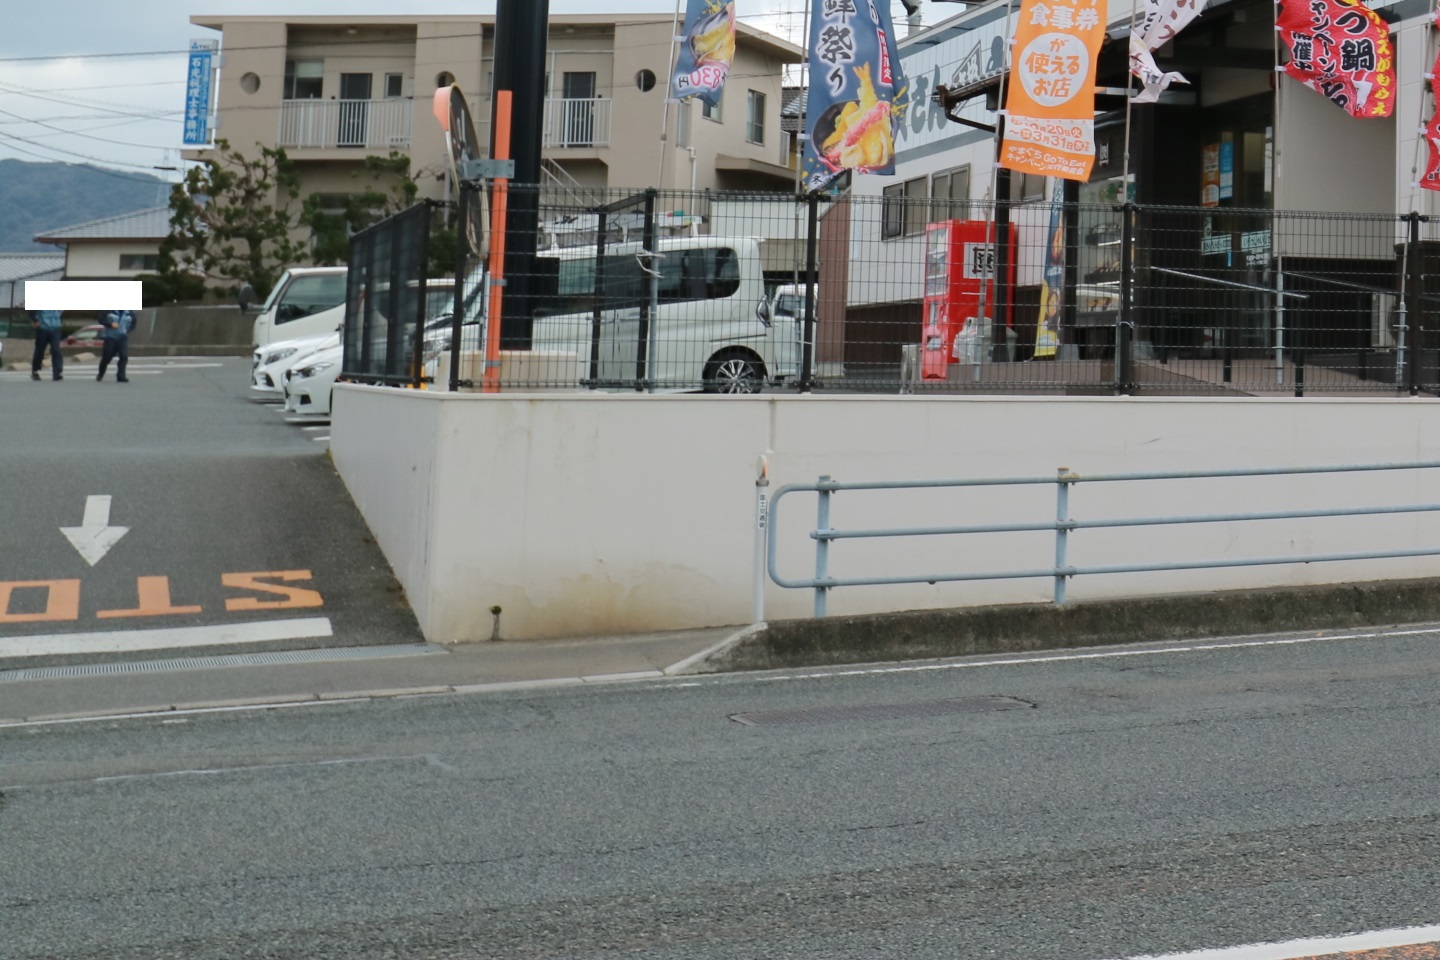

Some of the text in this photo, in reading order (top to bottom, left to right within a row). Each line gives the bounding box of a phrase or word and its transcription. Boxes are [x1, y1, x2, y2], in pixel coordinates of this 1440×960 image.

[1029, 2, 1099, 31] 食事券
[1050, 37, 1070, 52] が
[1025, 53, 1080, 75] 使える
[1032, 77, 1072, 98] お店
